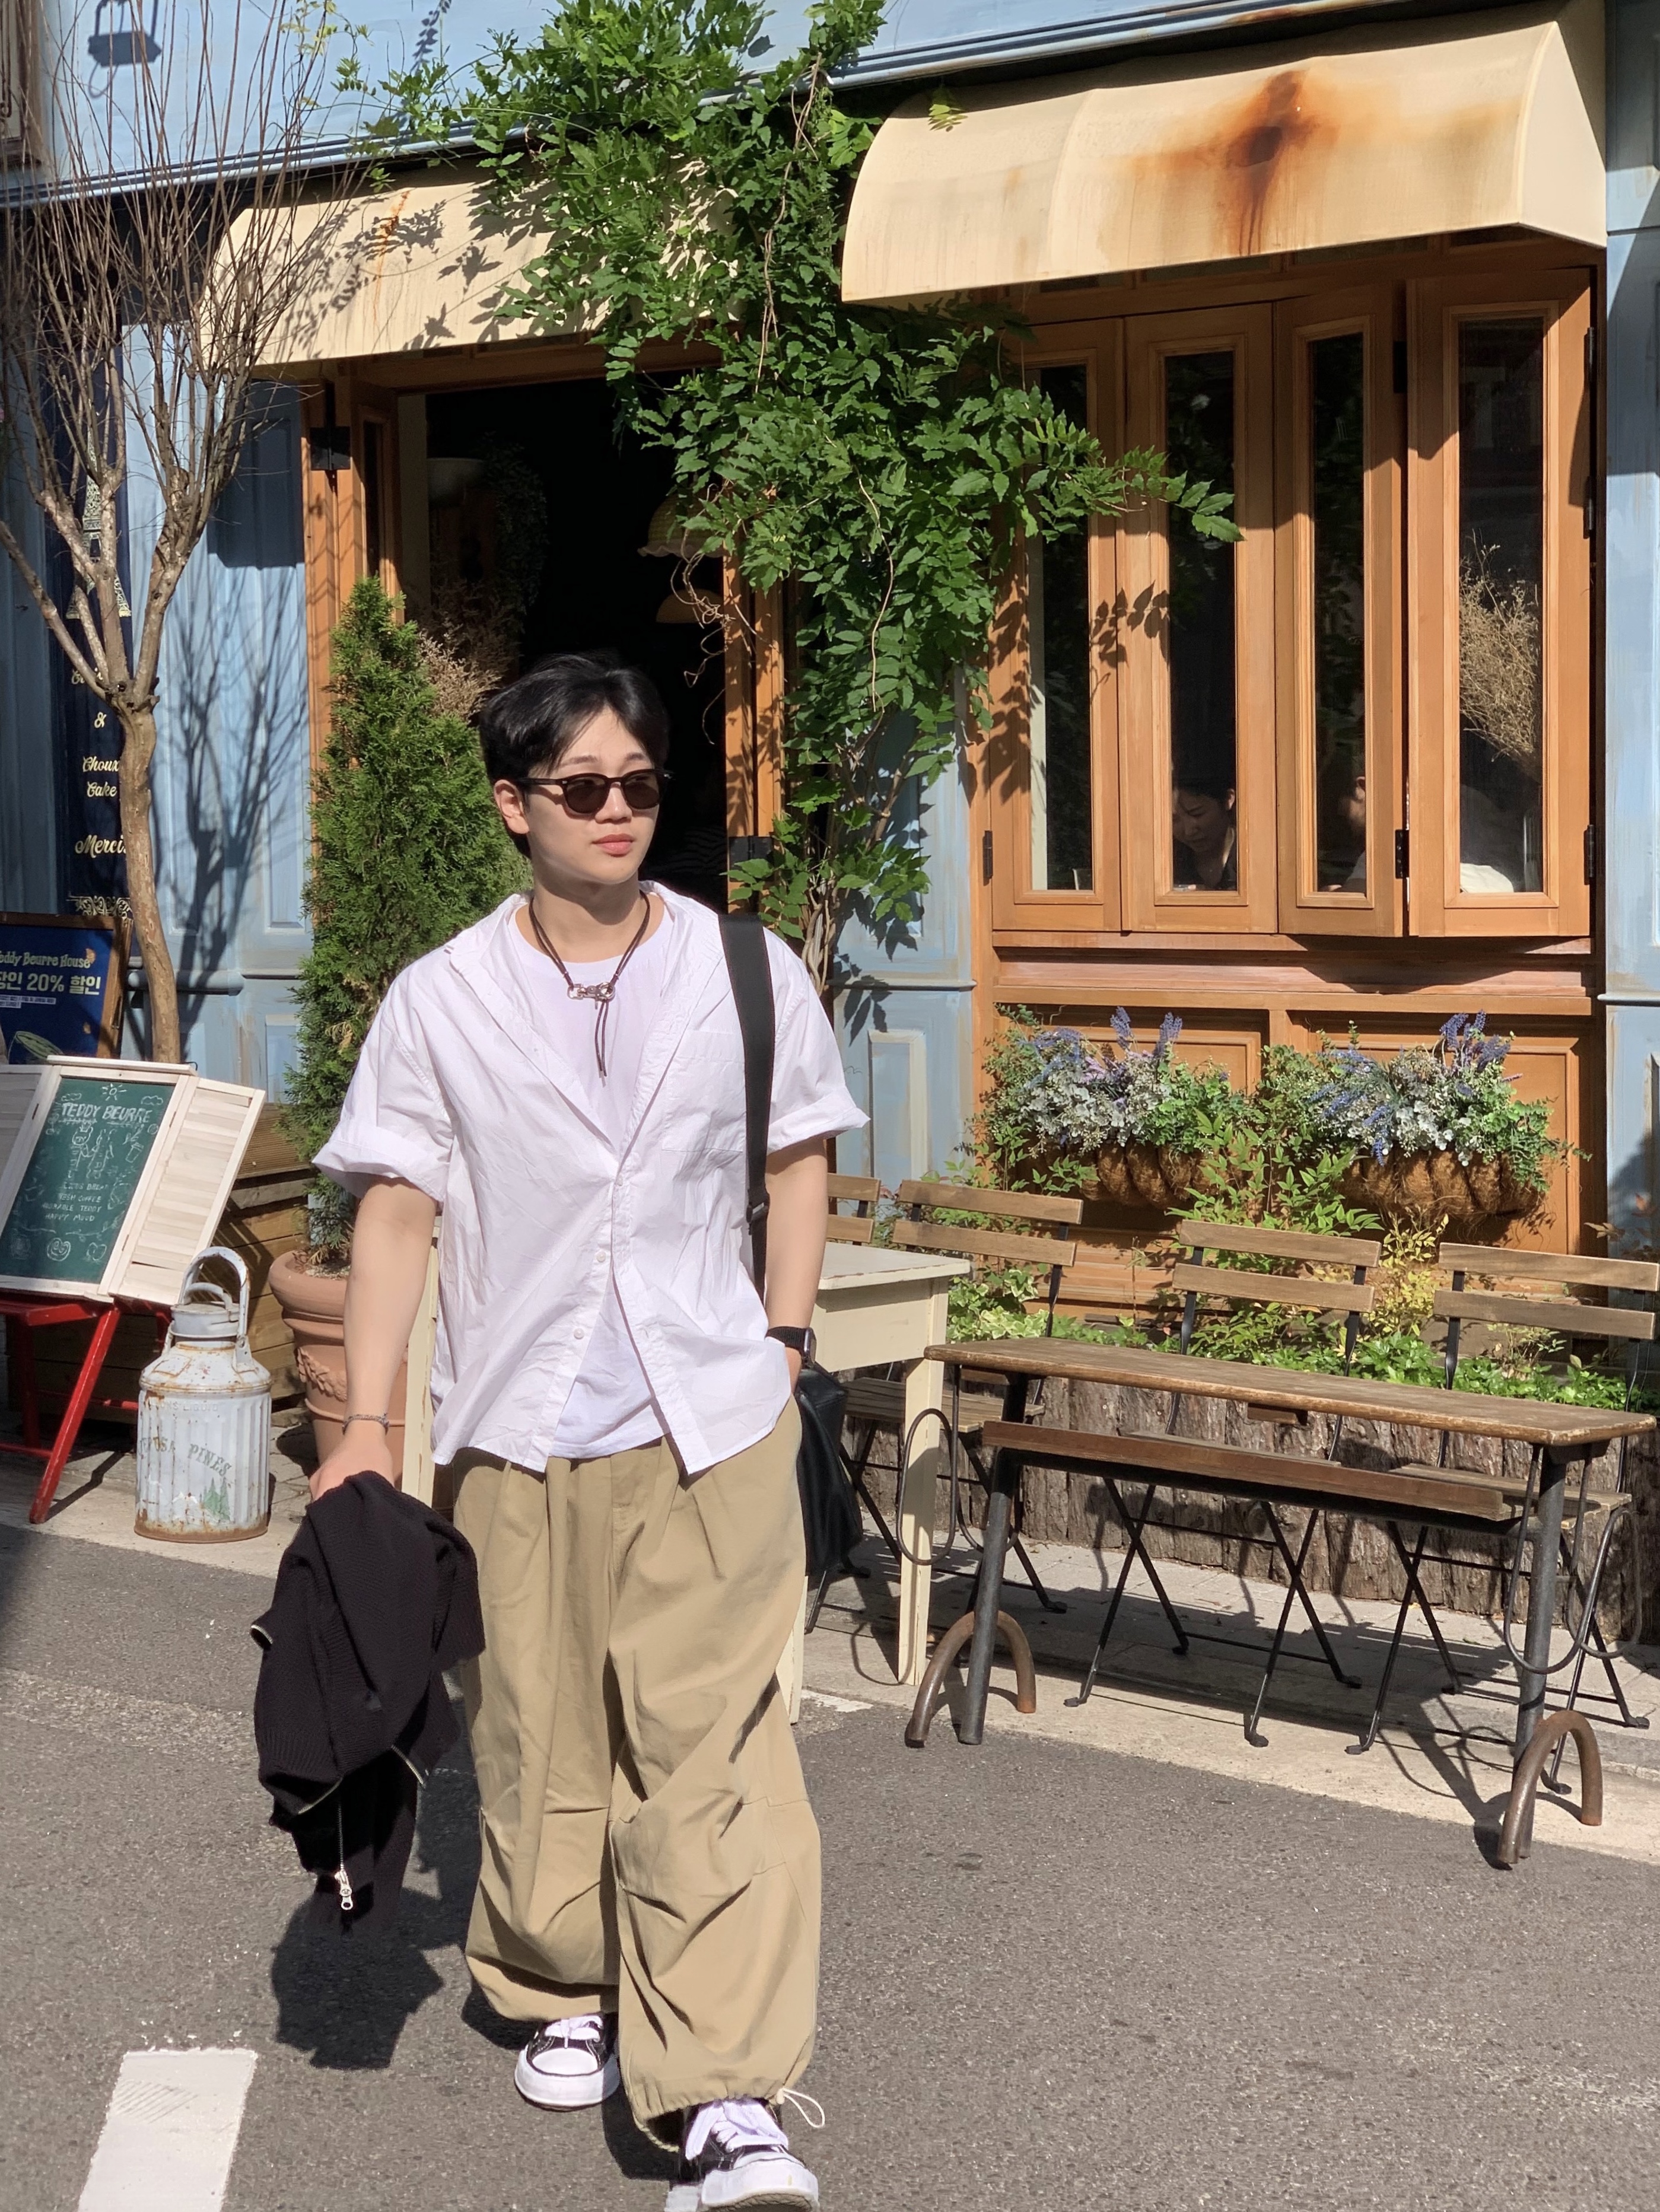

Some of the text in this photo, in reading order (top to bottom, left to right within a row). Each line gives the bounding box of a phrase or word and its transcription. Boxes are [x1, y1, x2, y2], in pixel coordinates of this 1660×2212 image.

[94, 712, 107, 728] &
[82, 756, 120, 772] Choux
[87, 781, 117, 797] Cake
[0, 951, 91, 969] eddy Beurre House
[27, 973, 64, 992] 20%
[69, 975, 101, 995] 할인
[62, 1102, 152, 1123] TEDDY BEURRE
[187, 1443, 231, 1476] PINES
